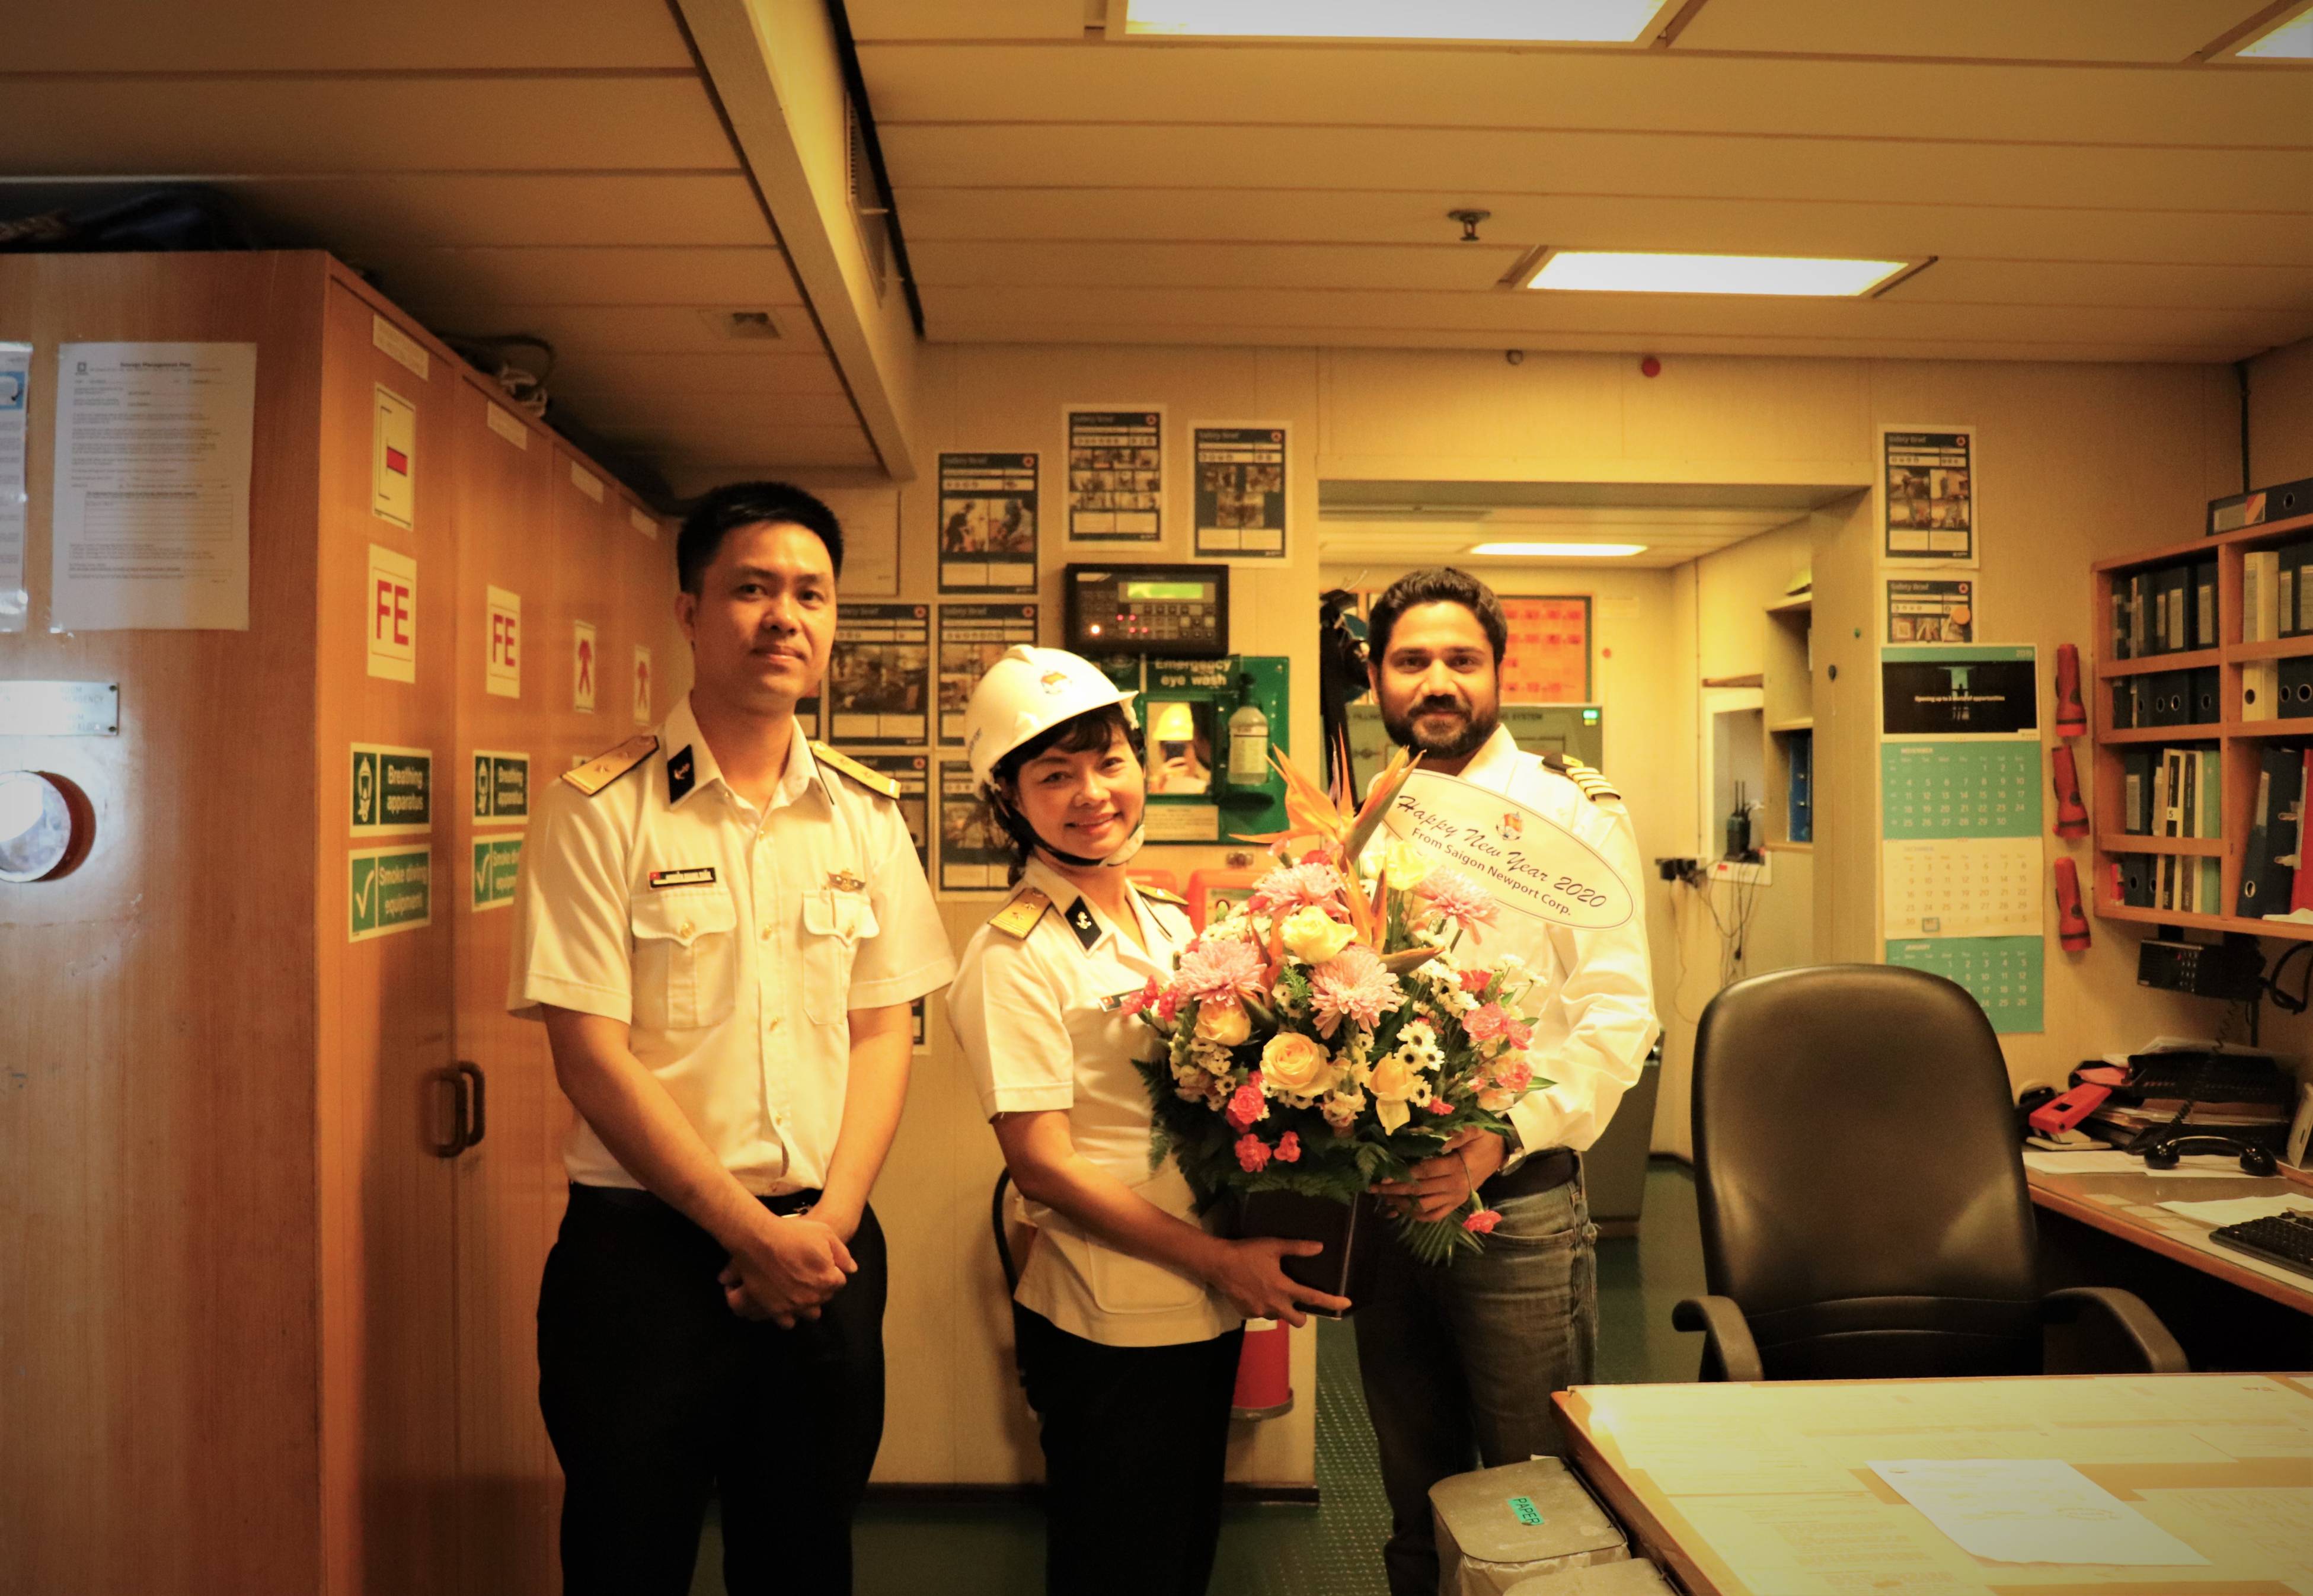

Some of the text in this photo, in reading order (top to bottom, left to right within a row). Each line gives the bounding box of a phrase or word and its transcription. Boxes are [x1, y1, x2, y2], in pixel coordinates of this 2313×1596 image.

[376, 579, 409, 646] FE
[493, 613, 515, 667] FE
[1161, 674, 1227, 687] eye wash
[388, 765, 423, 789] Breathing
[1964, 778, 1968, 786] 7
[387, 793, 423, 814] apparatus
[2168, 810, 2174, 818] 5
[1922, 818, 1932, 827] 26
[1942, 818, 1951, 826] 27
[1397, 795, 1606, 908] Happy New Year 2020
[379, 866, 405, 886] Smoke
[1412, 827, 1571, 916] From Saigon Newport Corp.
[386, 893, 422, 916] equipment
[1513, 1498, 1540, 1524] PAPER
